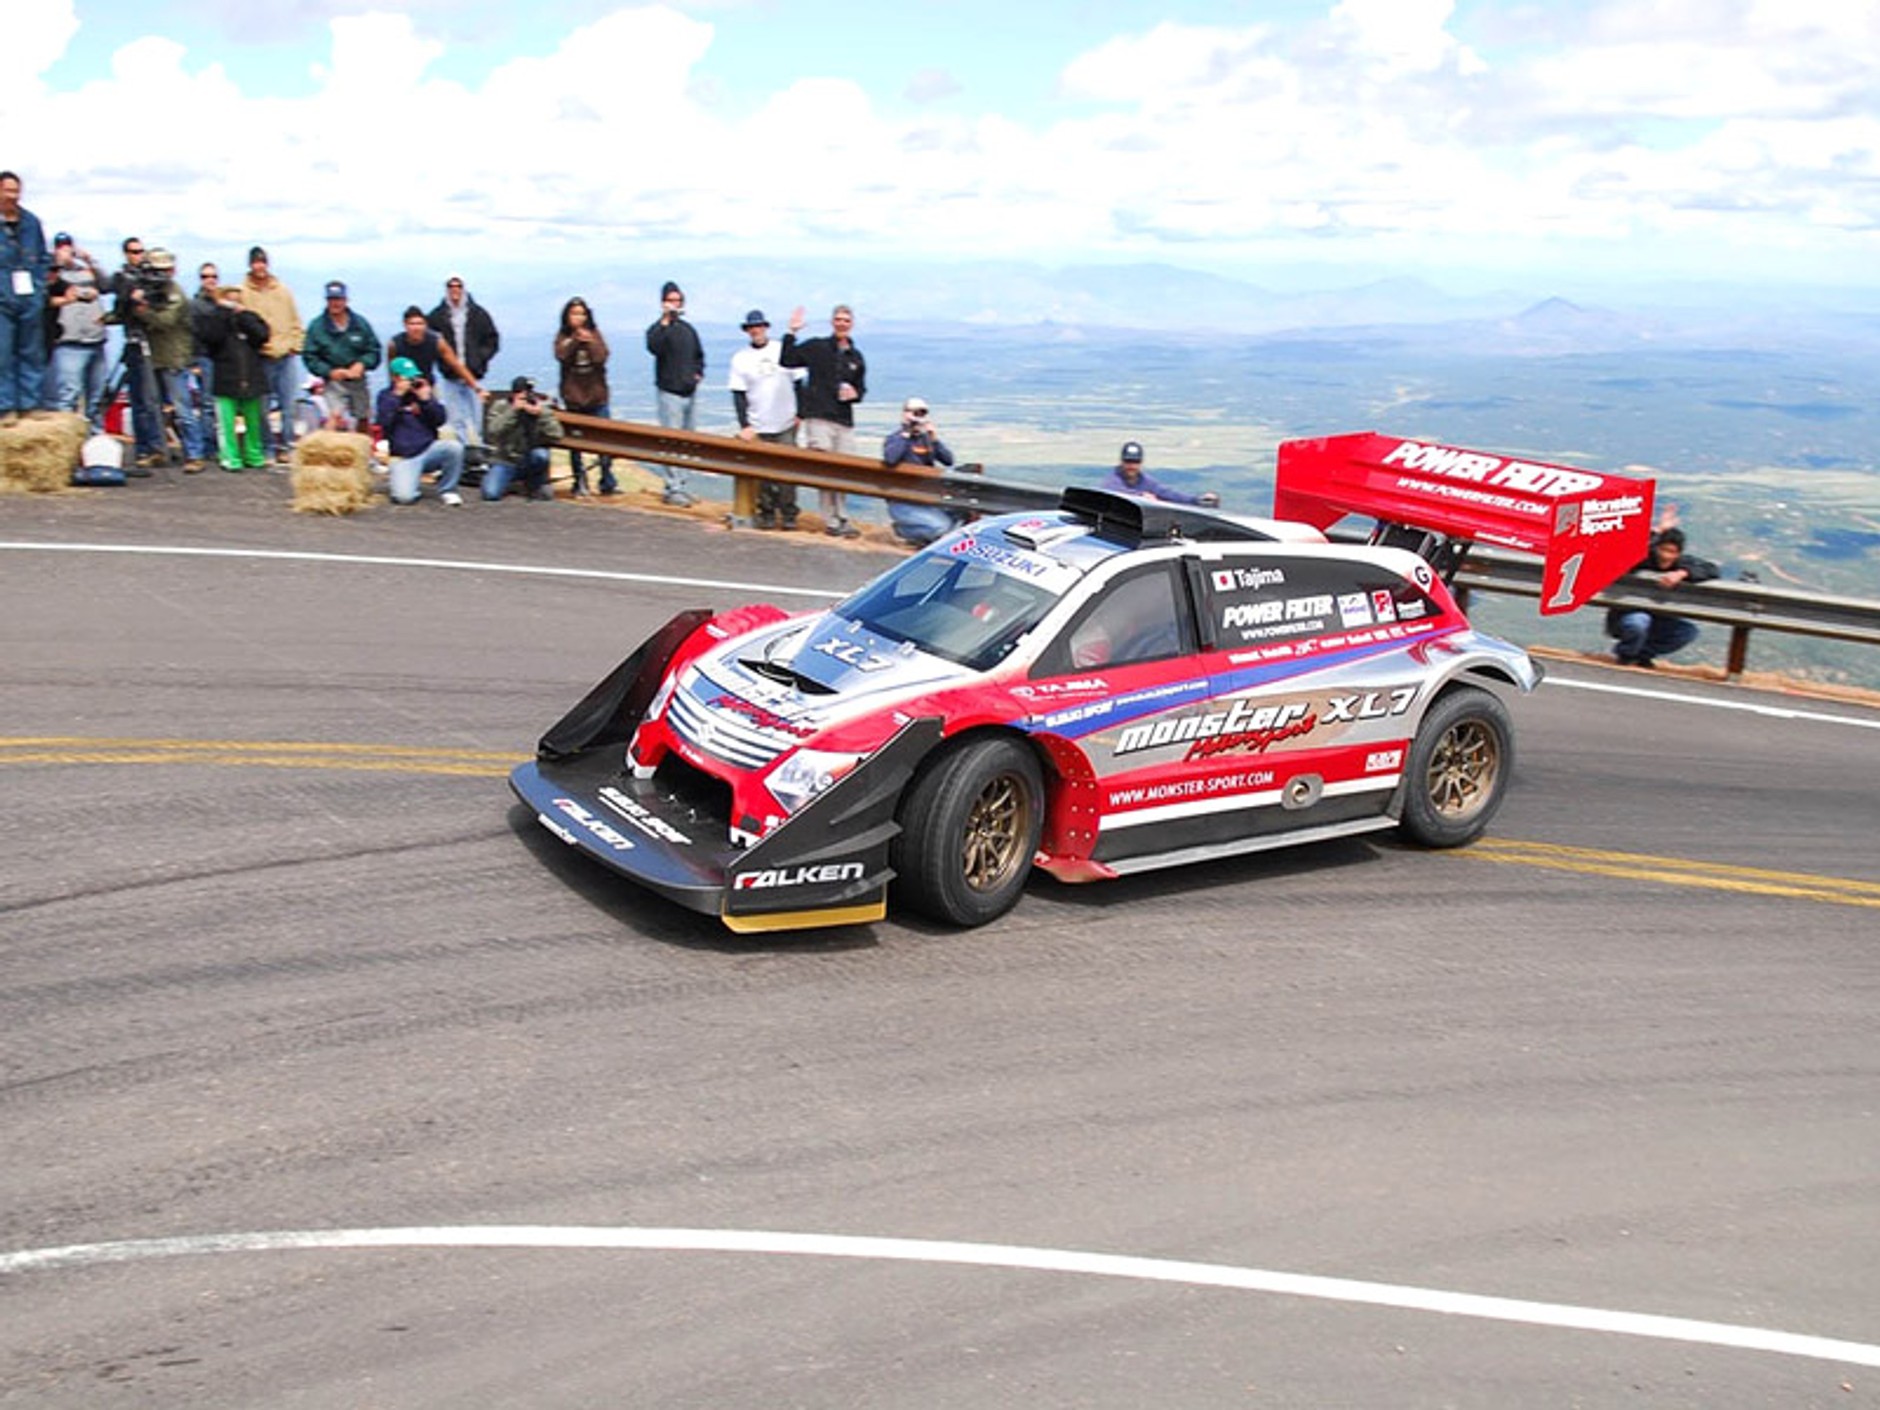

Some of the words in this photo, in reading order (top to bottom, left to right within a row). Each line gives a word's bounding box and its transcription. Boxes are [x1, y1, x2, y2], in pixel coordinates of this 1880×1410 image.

[1382, 441, 1502, 482] POWER
[1488, 461, 1604, 497] FILTER
[1234, 567, 1285, 590] Tajima
[1414, 566, 1430, 585] G
[1548, 553, 1584, 607] 1
[1222, 601, 1284, 629] POWER
[1285, 595, 1334, 619] FILTER
[1321, 688, 1418, 725] XL7
[1109, 771, 1274, 806] WWW.MONSTER-SPORT.COM
[734, 862, 864, 890] FALKEN
